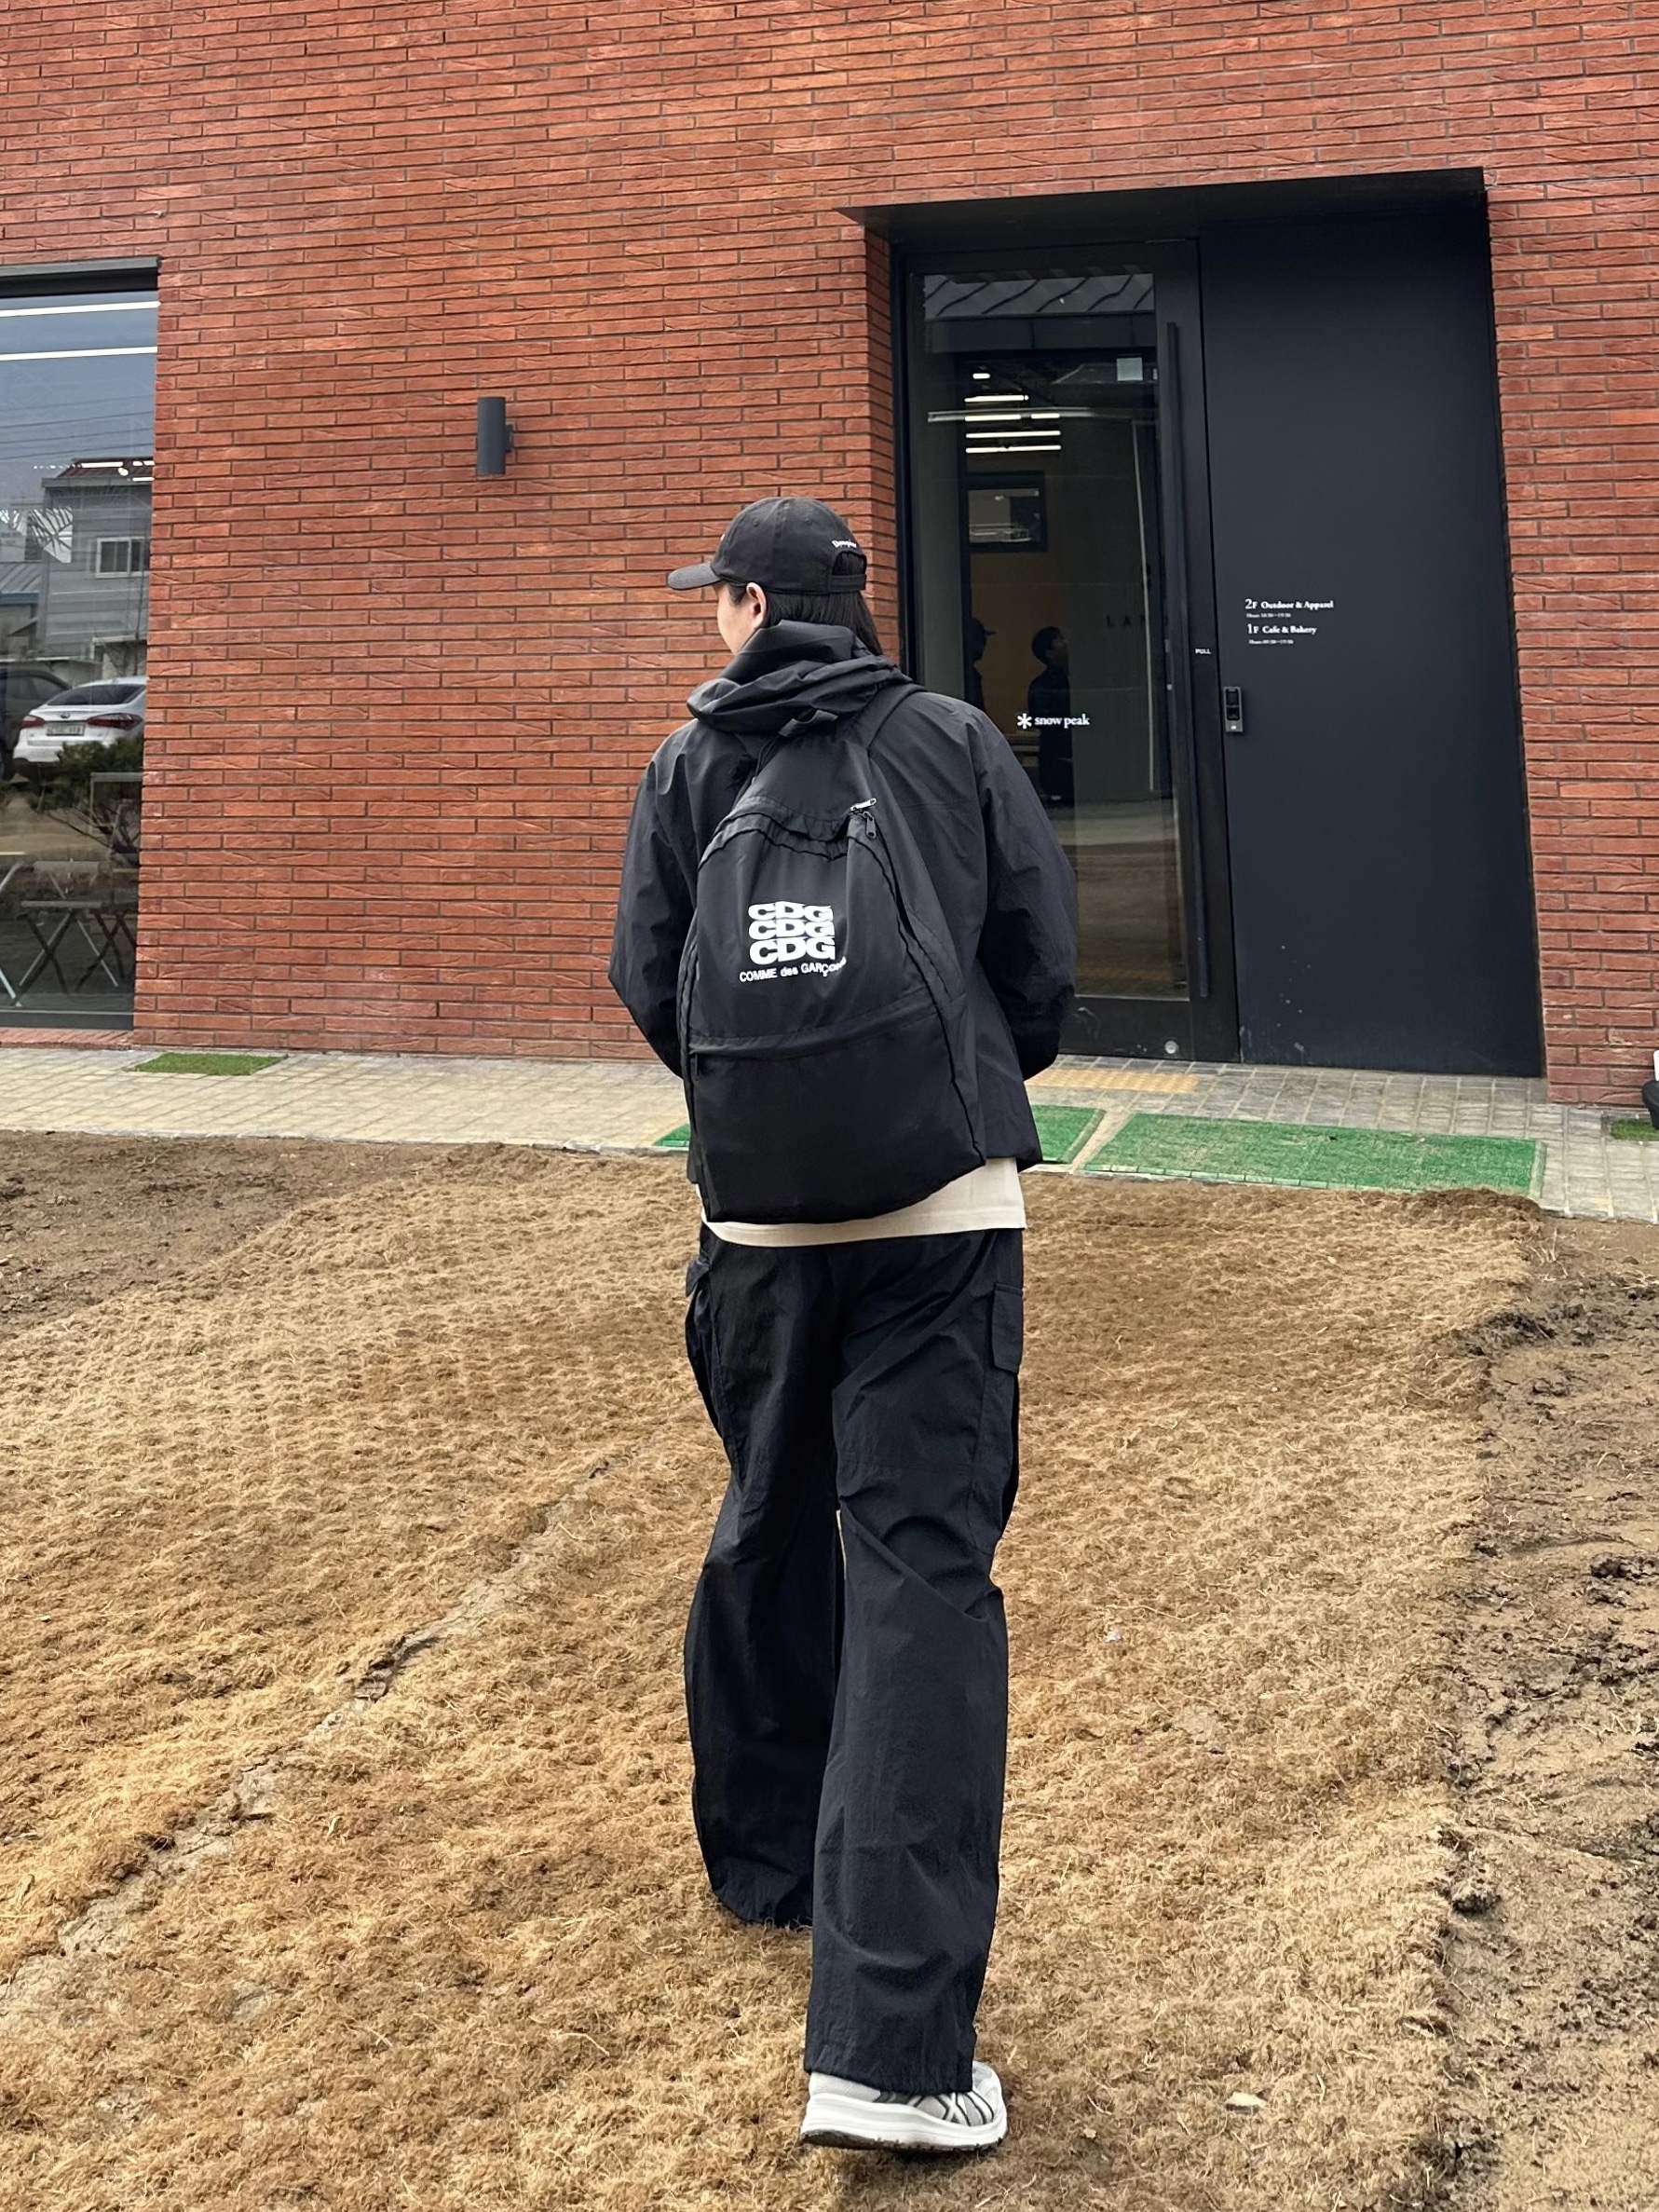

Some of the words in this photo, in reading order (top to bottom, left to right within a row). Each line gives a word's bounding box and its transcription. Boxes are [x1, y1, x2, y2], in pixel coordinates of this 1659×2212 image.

[1244, 598, 1258, 609] 2F
[1260, 600, 1294, 609] Outdoor
[1247, 623, 1259, 635] 1F
[1262, 625, 1281, 634] Cafe
[1290, 625, 1318, 635] Bakery
[1034, 717, 1063, 726] snow
[1064, 713, 1091, 729] peak
[748, 900, 834, 922] CDG
[748, 919, 836, 939] CDG
[749, 936, 836, 965] CDG
[739, 967, 778, 982] COMME
[780, 966, 798, 977] des
